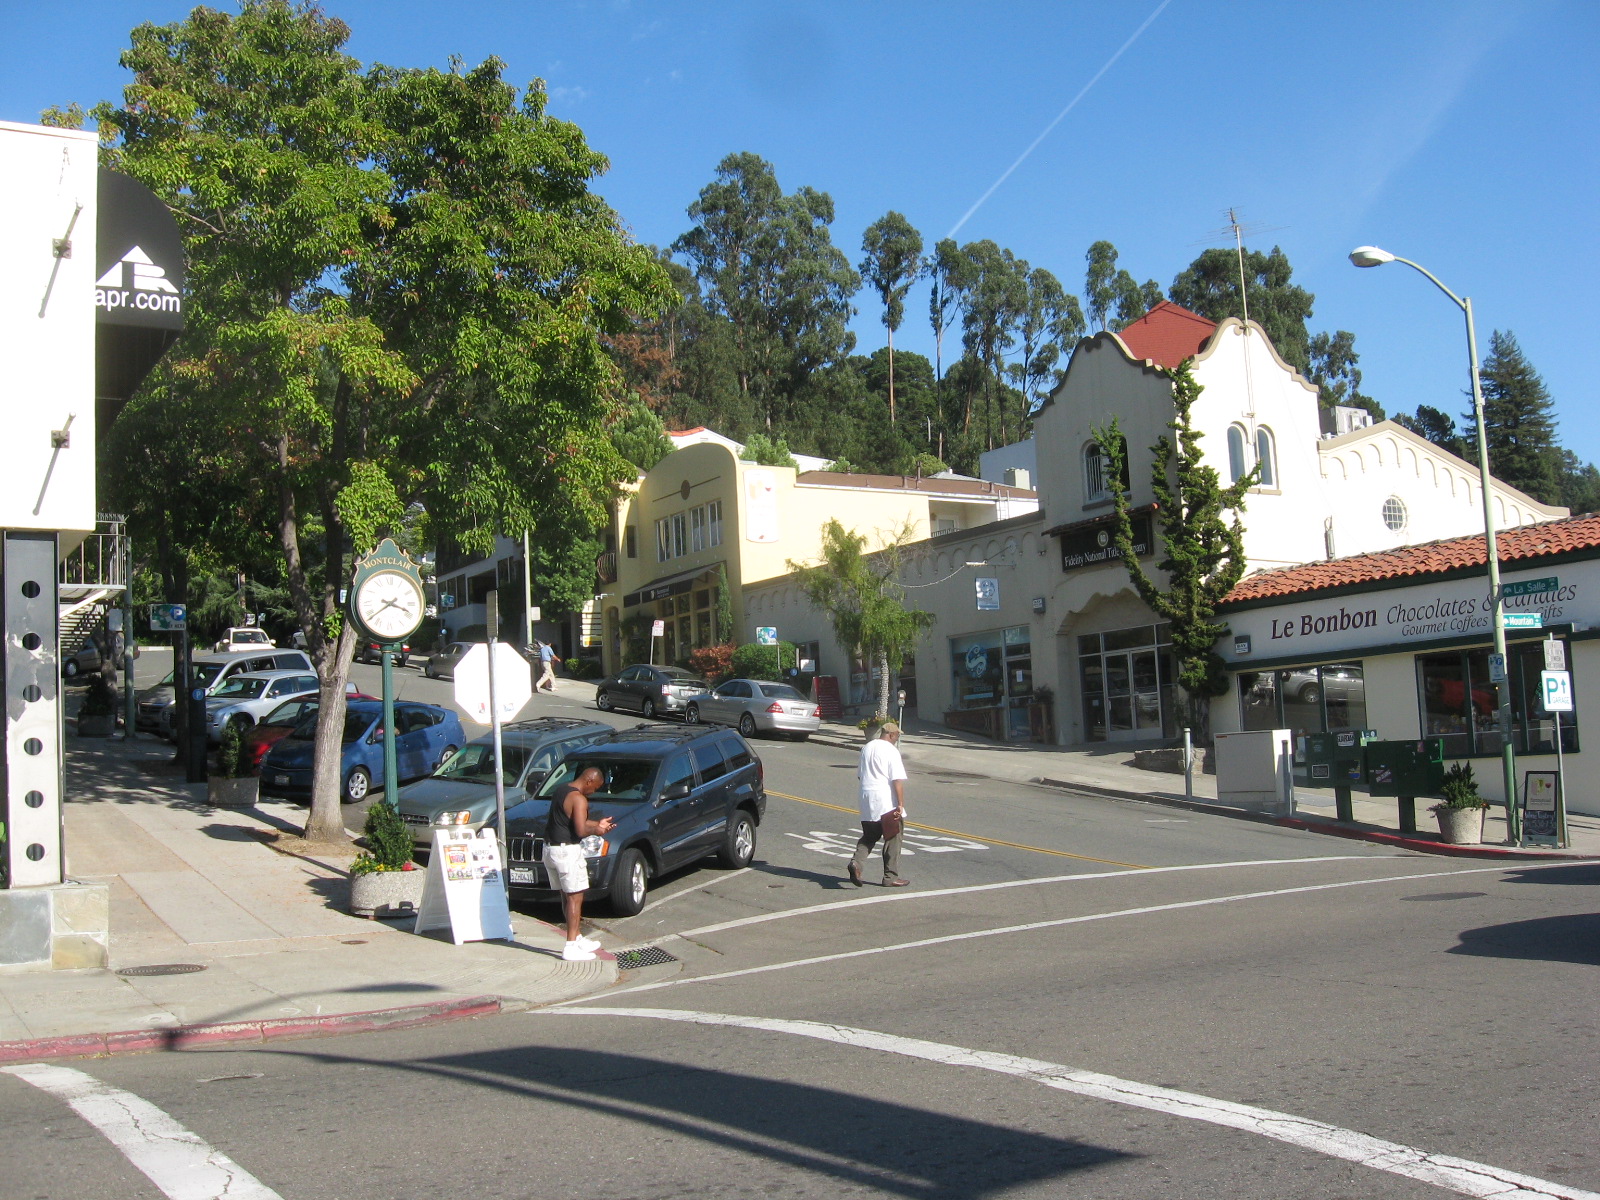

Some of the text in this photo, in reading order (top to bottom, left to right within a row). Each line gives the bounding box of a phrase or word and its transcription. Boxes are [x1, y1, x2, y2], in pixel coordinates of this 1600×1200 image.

[95, 289, 180, 312] apr.com
[363, 557, 412, 570] MONTCLAIR
[1064, 553, 1084, 567] Fidelity
[1084, 548, 1107, 562] National
[1107, 546, 1120, 558] Title
[1513, 584, 1524, 594] La
[1527, 582, 1546, 592] Salle
[1271, 619, 1294, 640] Le
[1300, 607, 1378, 636] Bonbon
[1387, 598, 1477, 624] Chocolates
[1401, 621, 1448, 637] Gourmet
[1450, 615, 1489, 633] Coffees
[1509, 616, 1534, 626] Mountain
[1546, 678, 1558, 705] P
[1551, 696, 1570, 705] GARAGE
